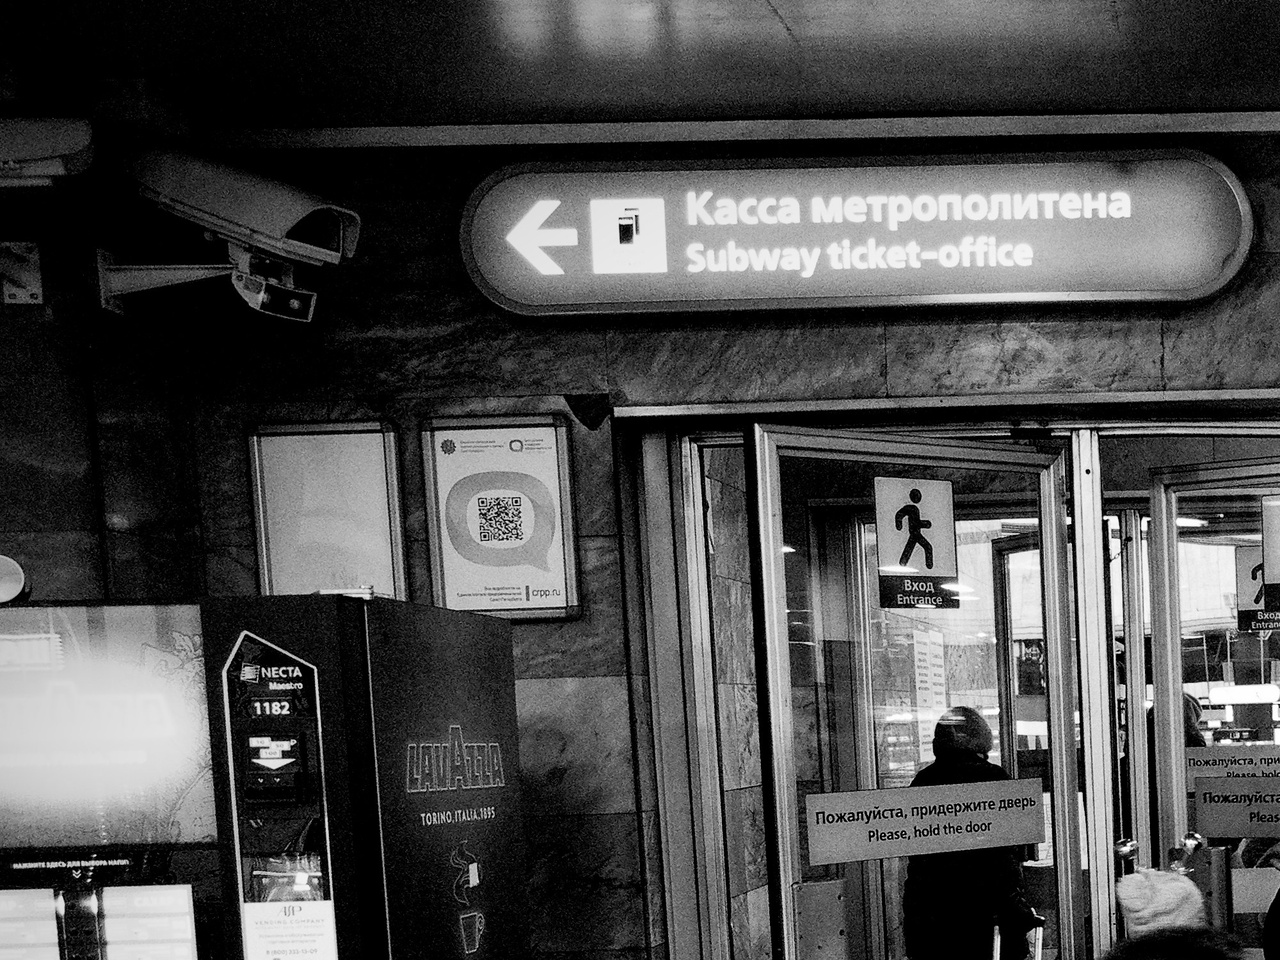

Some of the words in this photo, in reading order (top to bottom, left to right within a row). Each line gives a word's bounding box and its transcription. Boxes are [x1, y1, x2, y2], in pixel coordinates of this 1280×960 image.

[686, 190, 801, 226] Касса
[811, 191, 1132, 231] метрополитена
[686, 240, 821, 278] Subway
[827, 236, 1034, 270] ticket-office
[904, 580, 935, 593] Вход
[897, 594, 943, 605] Entrance
[261, 667, 302, 678] NECTA
[254, 702, 290, 715] 1182
[407, 725, 505, 793] LAVAZZA
[1188, 756, 1257, 768] Пожалуйста,
[815, 806, 908, 825] Пожалуйста,
[911, 800, 996, 819] придержите
[998, 796, 1036, 811] дверь
[868, 829, 911, 842] Please,
[914, 824, 940, 838] hold
[943, 822, 963, 836] the
[965, 820, 993, 833] door
